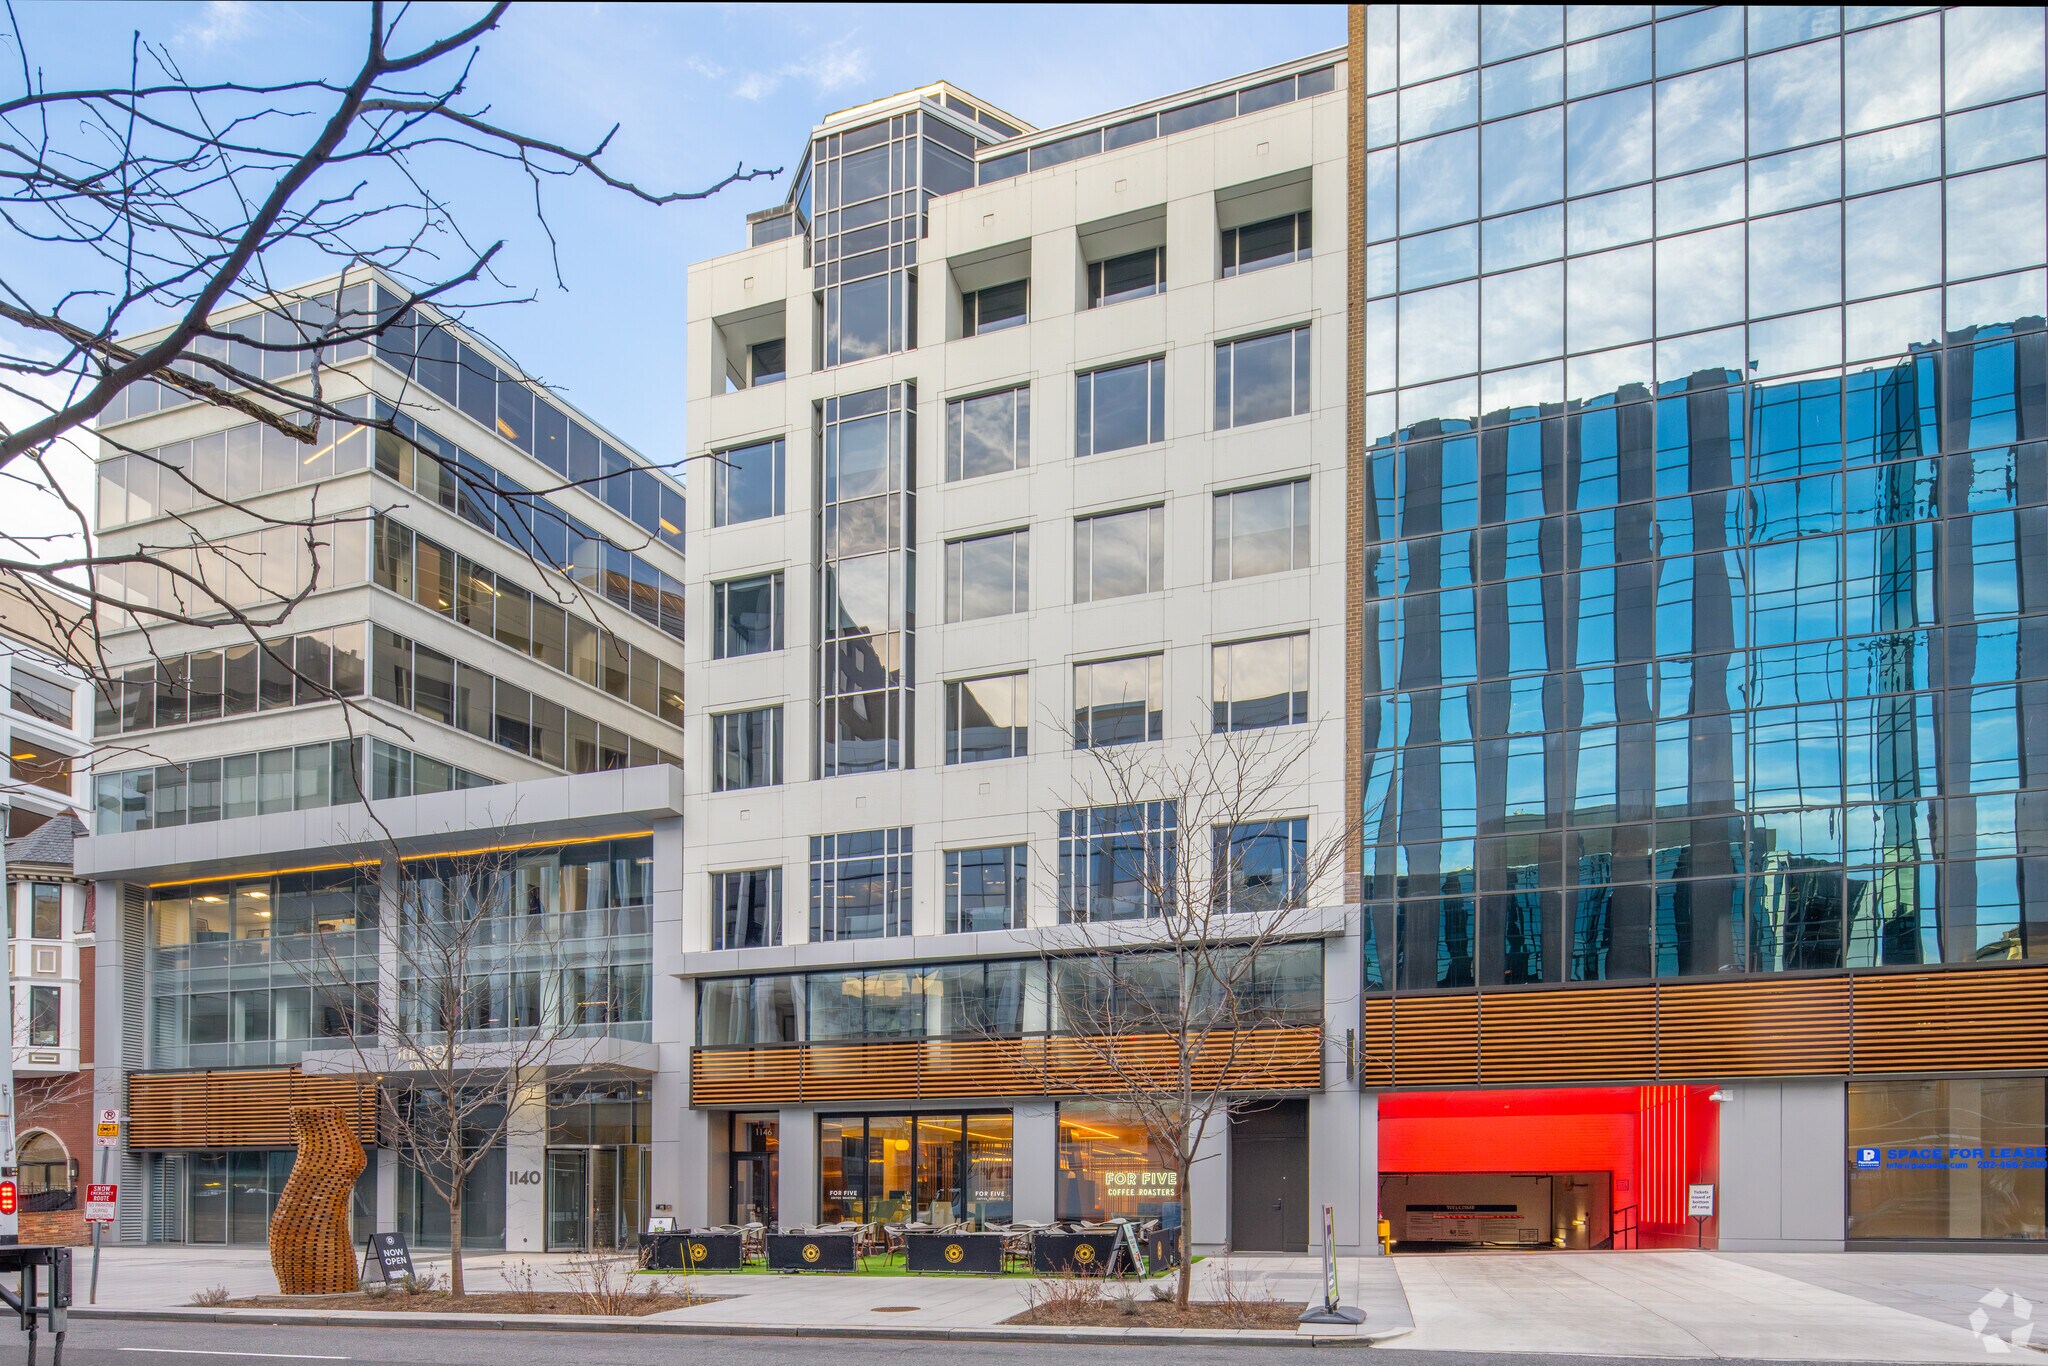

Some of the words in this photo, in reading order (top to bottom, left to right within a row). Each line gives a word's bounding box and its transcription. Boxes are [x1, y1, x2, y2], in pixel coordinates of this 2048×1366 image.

[1887, 1148, 1943, 1159] SPACE
[1949, 1148, 1985, 1159] FOR
[1989, 1147, 2047, 1159] LEASE
[510, 1171, 541, 1185] 1140
[1105, 1172, 1136, 1185] FOR
[1142, 1172, 1177, 1185] FIVE
[1108, 1188, 1135, 1196] COFFEE
[1139, 1188, 1175, 1196] ROASTERS
[383, 1248, 404, 1257] NOW
[385, 1256, 407, 1265] OPEN
